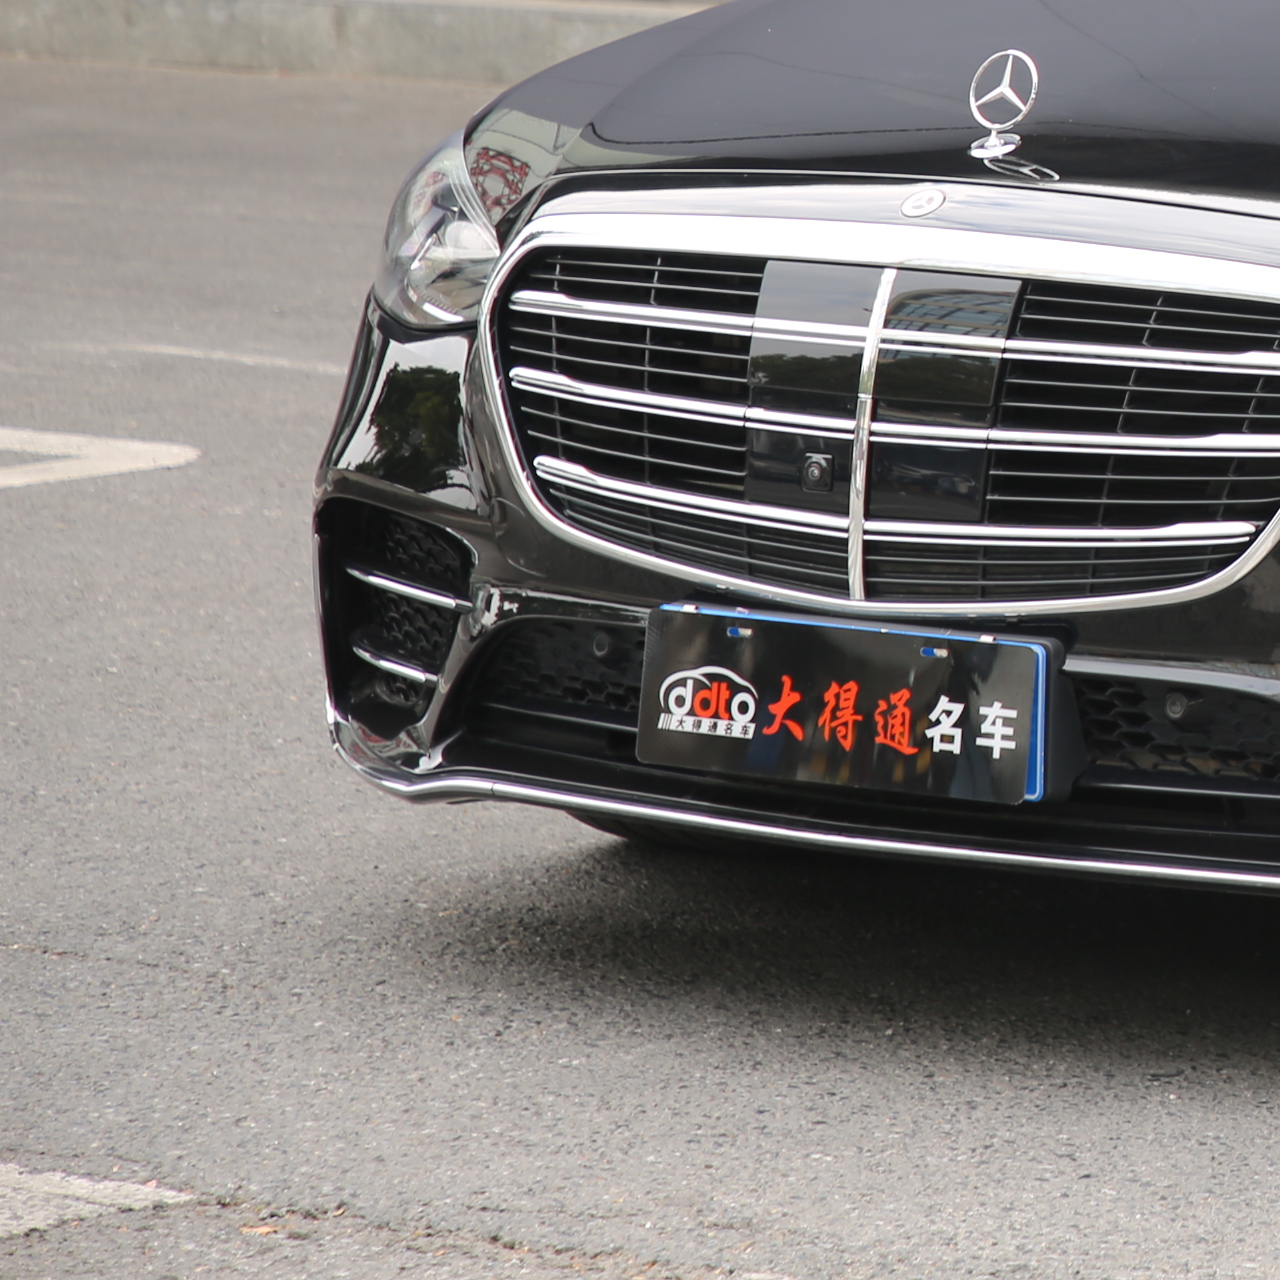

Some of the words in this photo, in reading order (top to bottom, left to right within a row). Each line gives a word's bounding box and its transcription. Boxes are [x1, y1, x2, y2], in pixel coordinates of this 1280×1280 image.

[668, 678, 756, 723] ddto
[762, 674, 1017, 760] 大得通名车
[675, 717, 751, 738] 大得通名车
